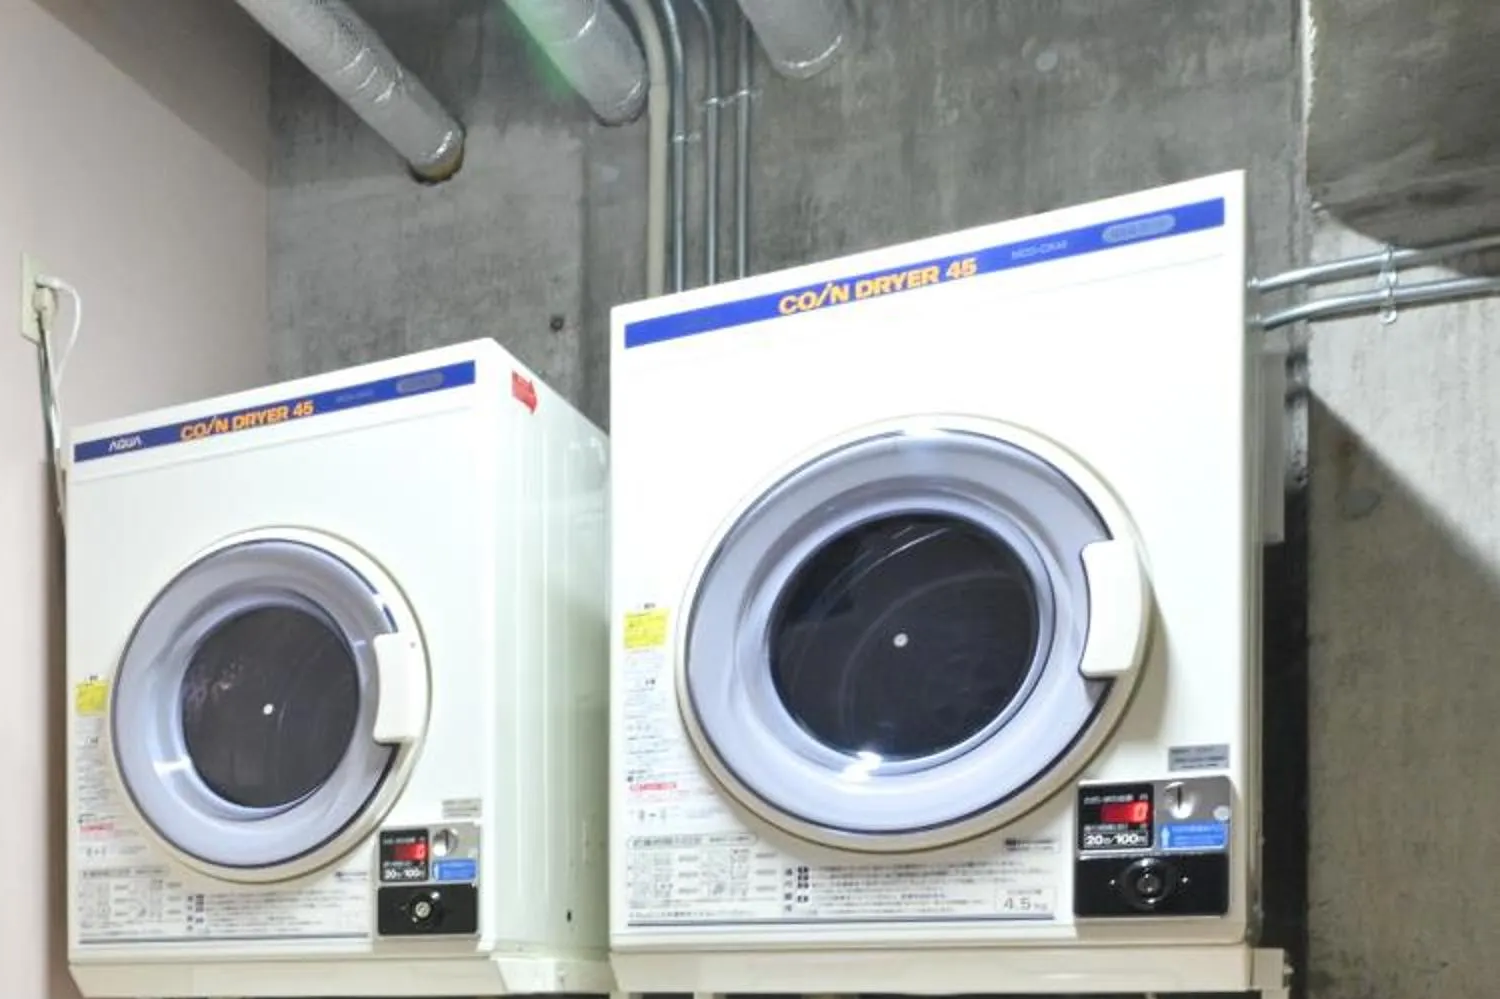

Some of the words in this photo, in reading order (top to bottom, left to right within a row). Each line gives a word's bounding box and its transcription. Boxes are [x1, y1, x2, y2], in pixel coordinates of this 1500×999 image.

[856, 266, 941, 301] DRYER
[946, 259, 978, 280] 45
[108, 436, 143, 451] AQUA
[232, 404, 288, 431] DRYER
[293, 401, 315, 417] 45
